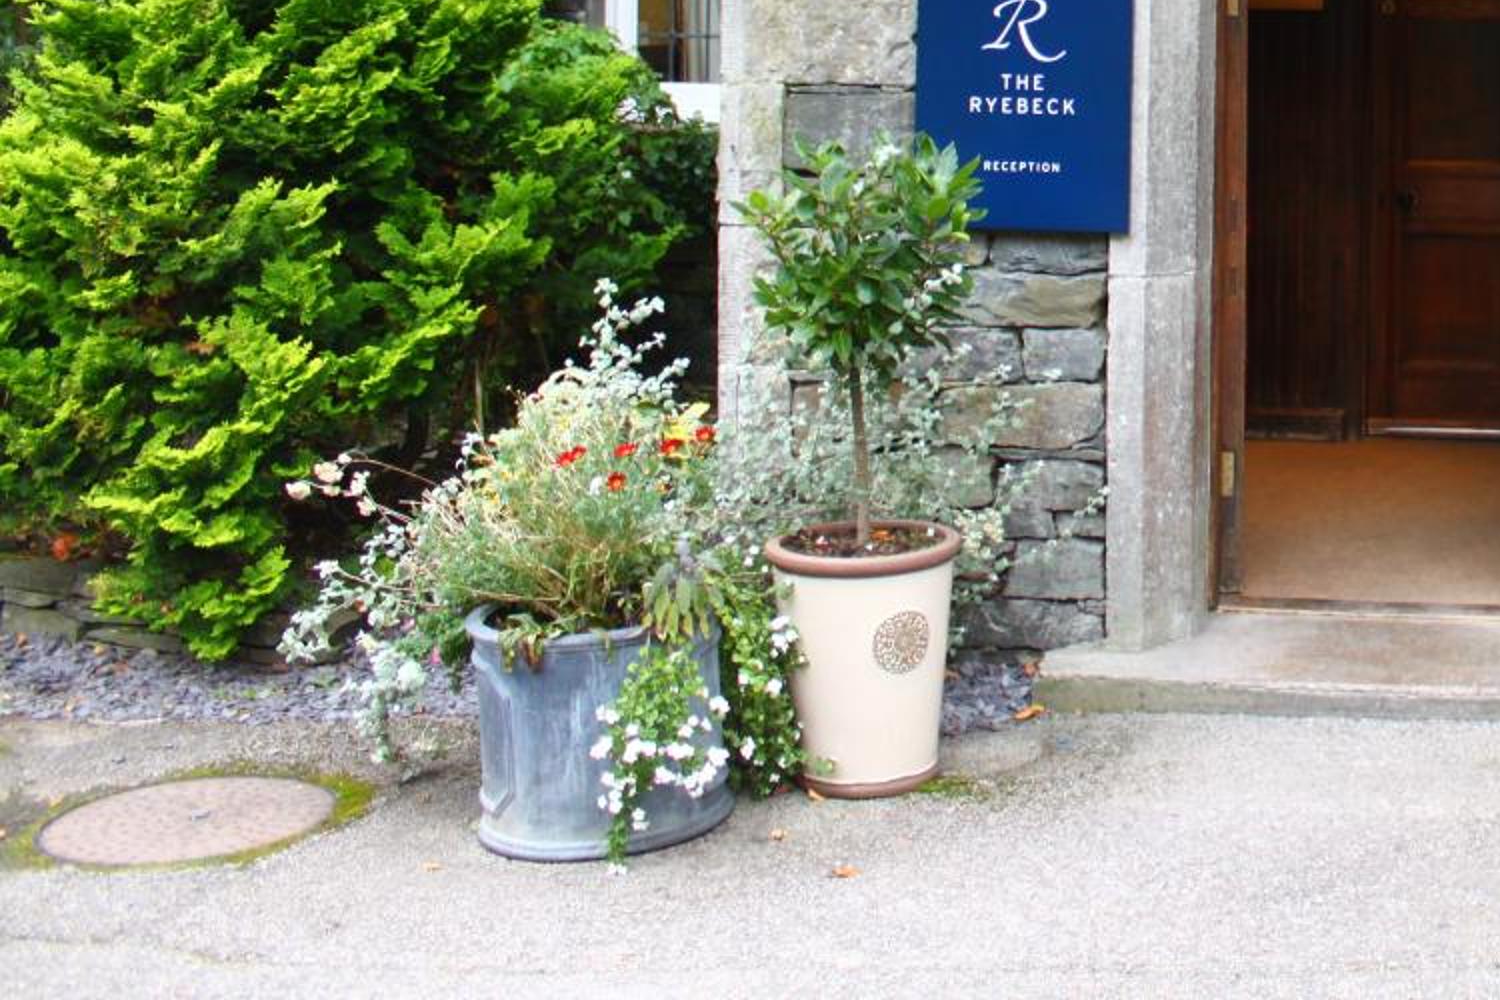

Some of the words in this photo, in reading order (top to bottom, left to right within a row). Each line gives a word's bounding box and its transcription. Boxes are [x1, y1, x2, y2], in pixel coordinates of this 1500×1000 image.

[1001, 73, 1045, 92] THE
[968, 95, 1076, 116] RYEBECK
[982, 160, 1061, 173] RECEPTION
